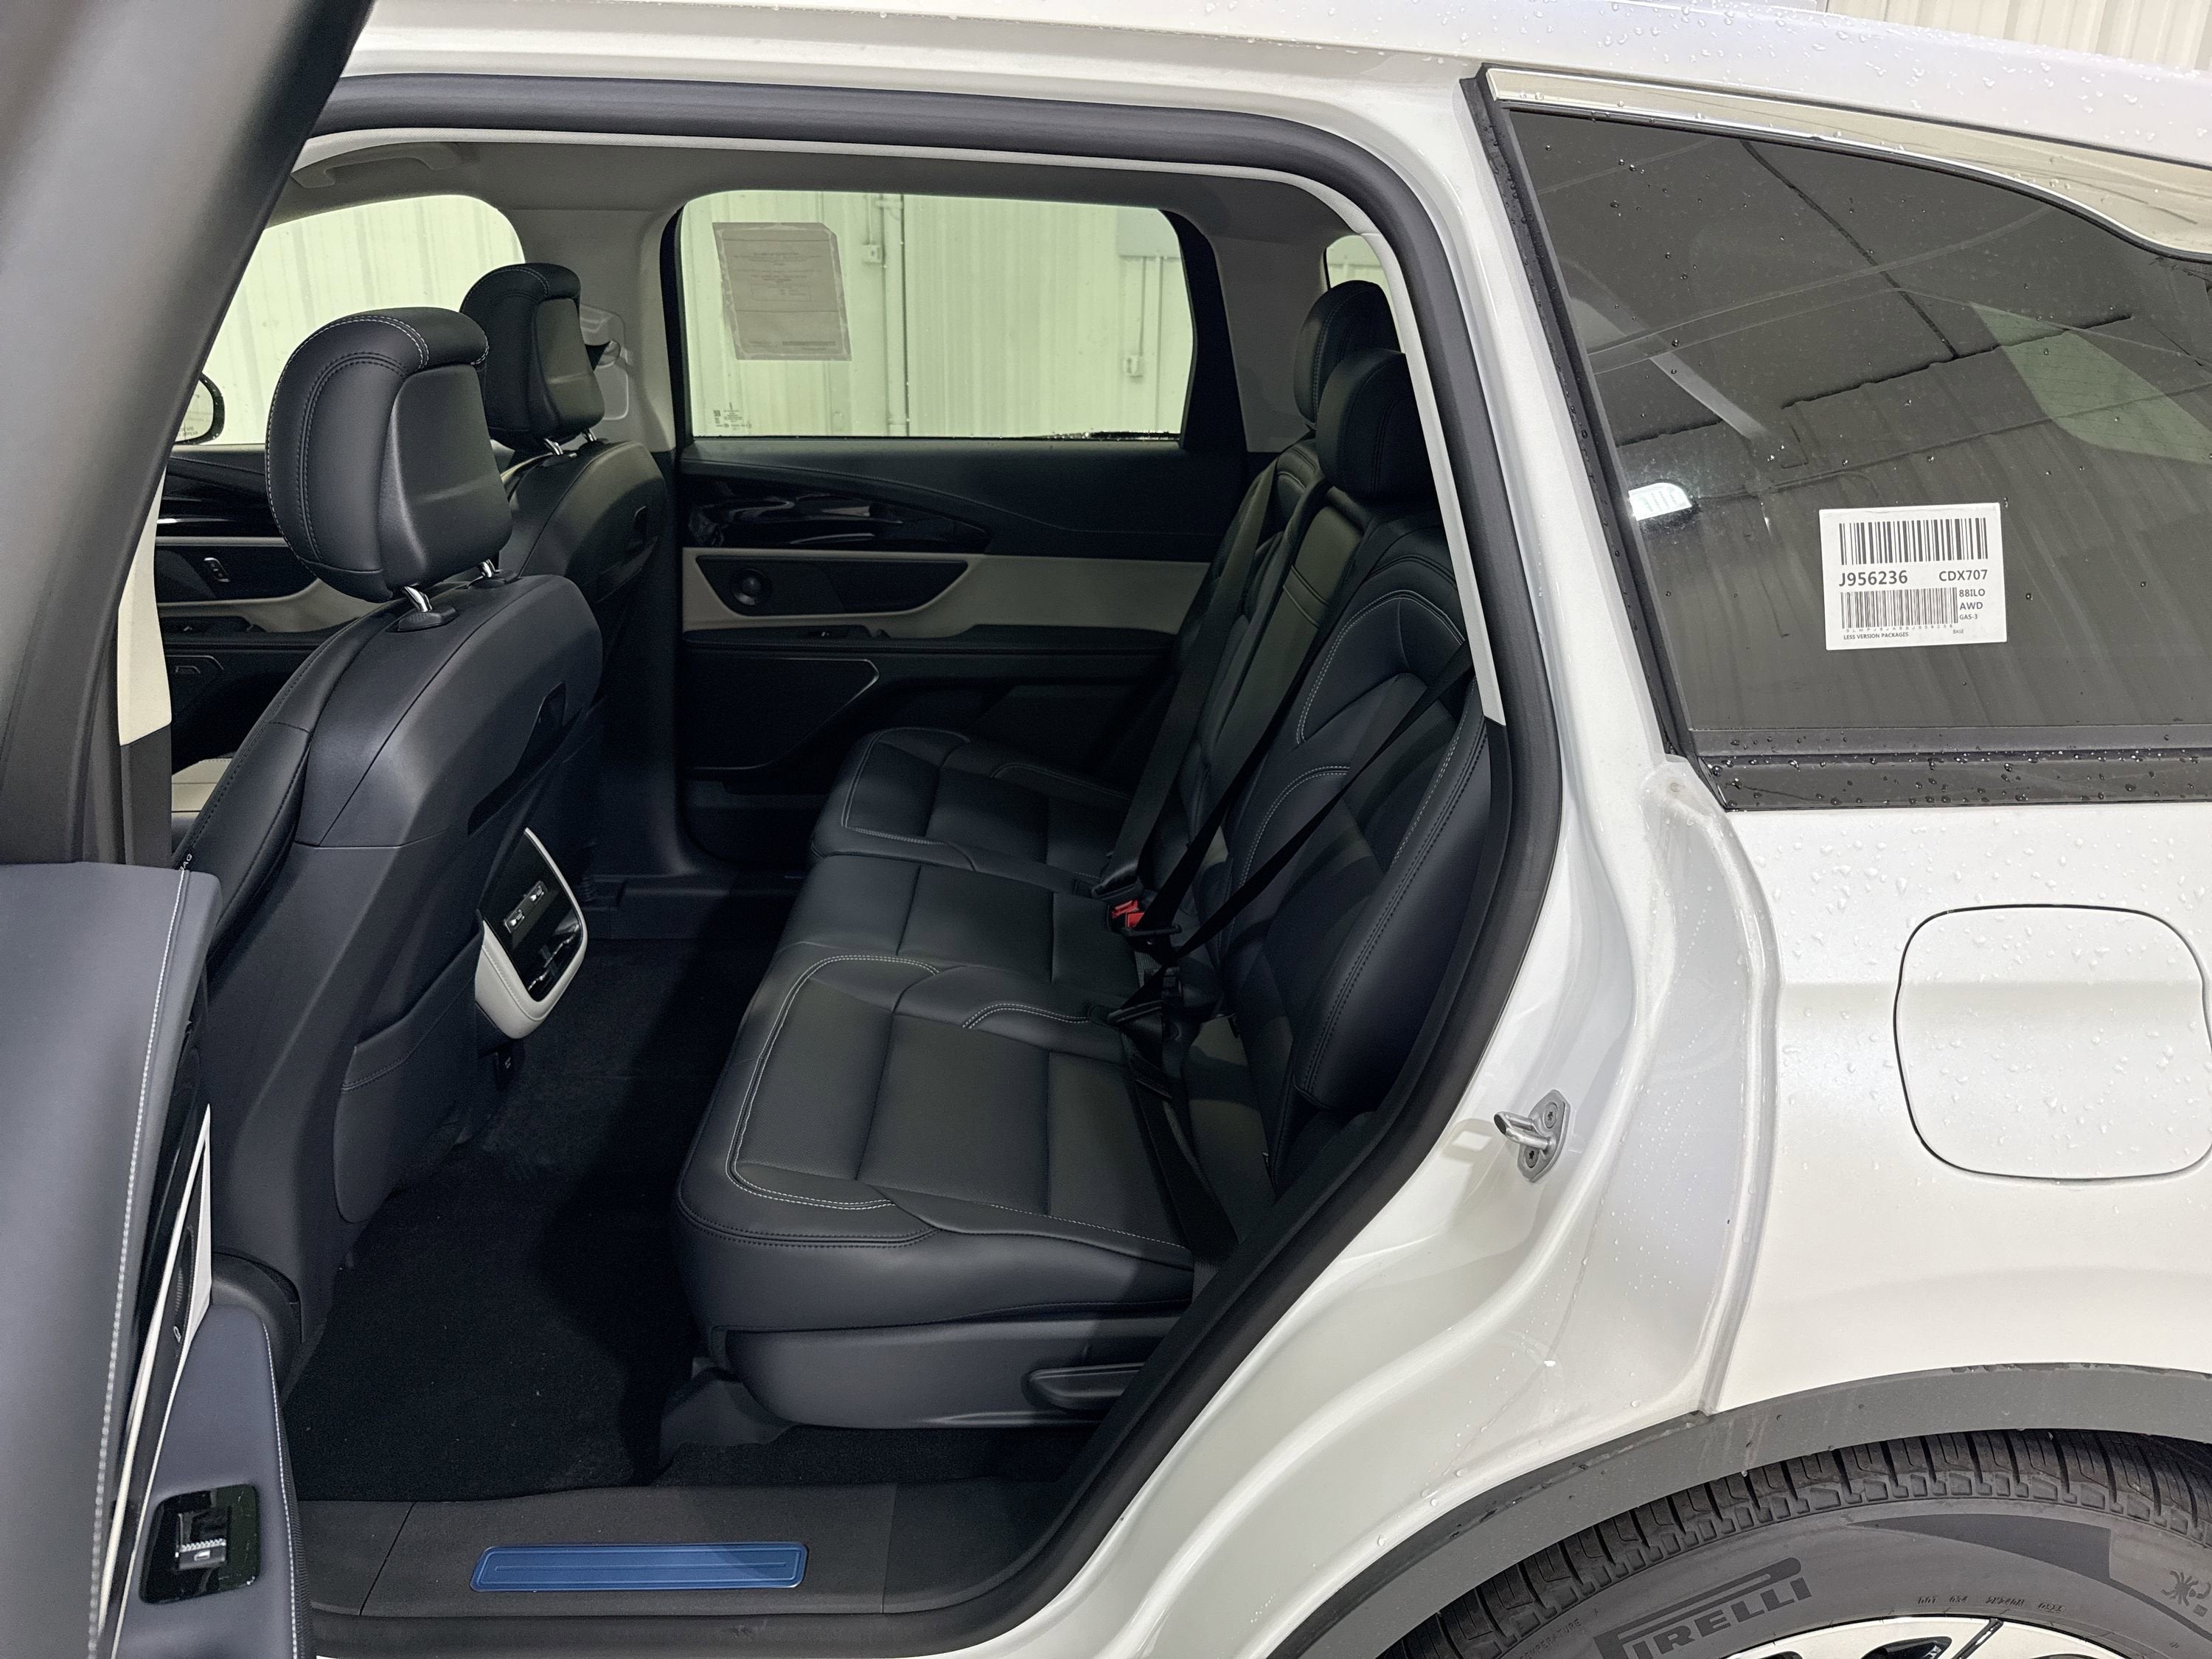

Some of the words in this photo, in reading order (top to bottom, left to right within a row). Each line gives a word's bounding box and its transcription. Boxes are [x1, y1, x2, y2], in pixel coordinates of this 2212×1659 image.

[1838, 570, 1908, 587] J956236
[1938, 569, 1988, 582] CDX707
[1959, 602, 1983, 611] AWD
[1593, 1557, 1812, 1659] PIRELLI
